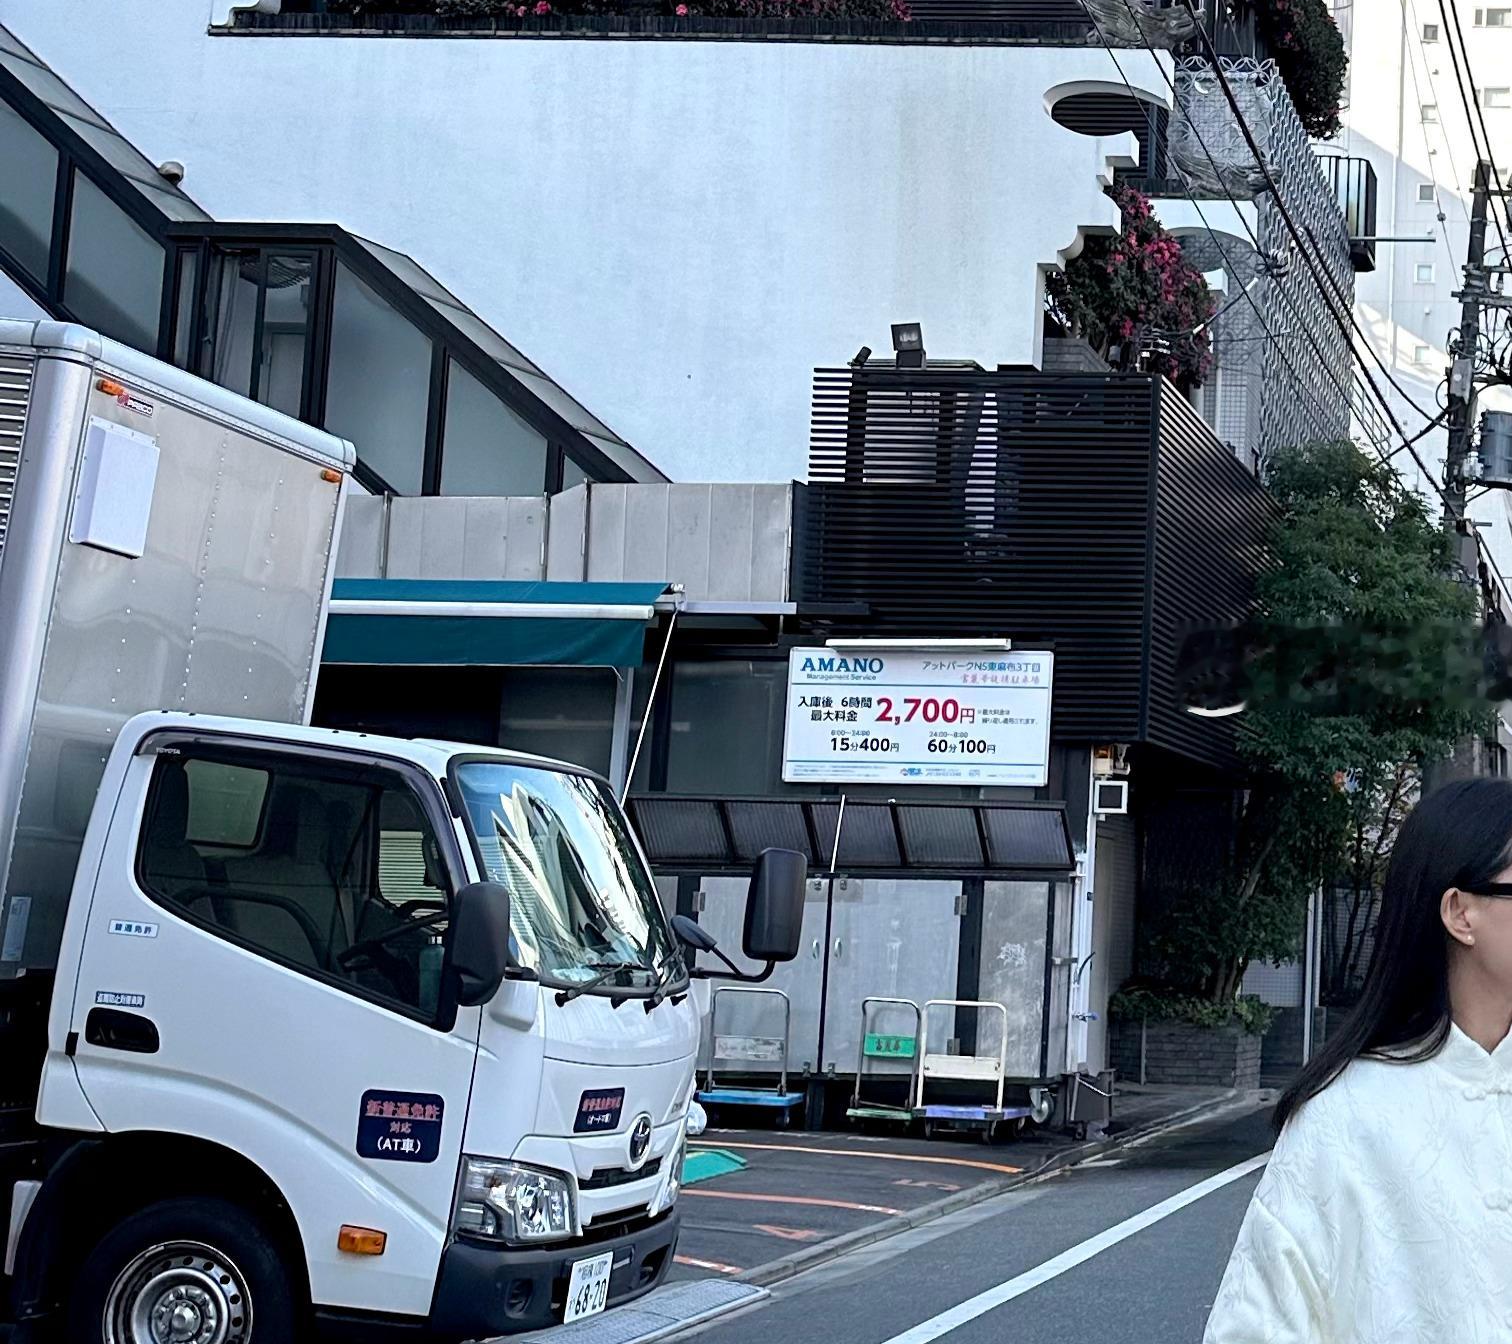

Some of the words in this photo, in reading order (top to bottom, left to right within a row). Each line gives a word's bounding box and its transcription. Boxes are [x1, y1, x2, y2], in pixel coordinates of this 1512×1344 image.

[800, 657, 884, 673] AMANO
[806, 673, 849, 681] Management
[798, 696, 833, 708] 入庫後
[841, 697, 872, 708] 6時間
[810, 709, 858, 722] 最大料金
